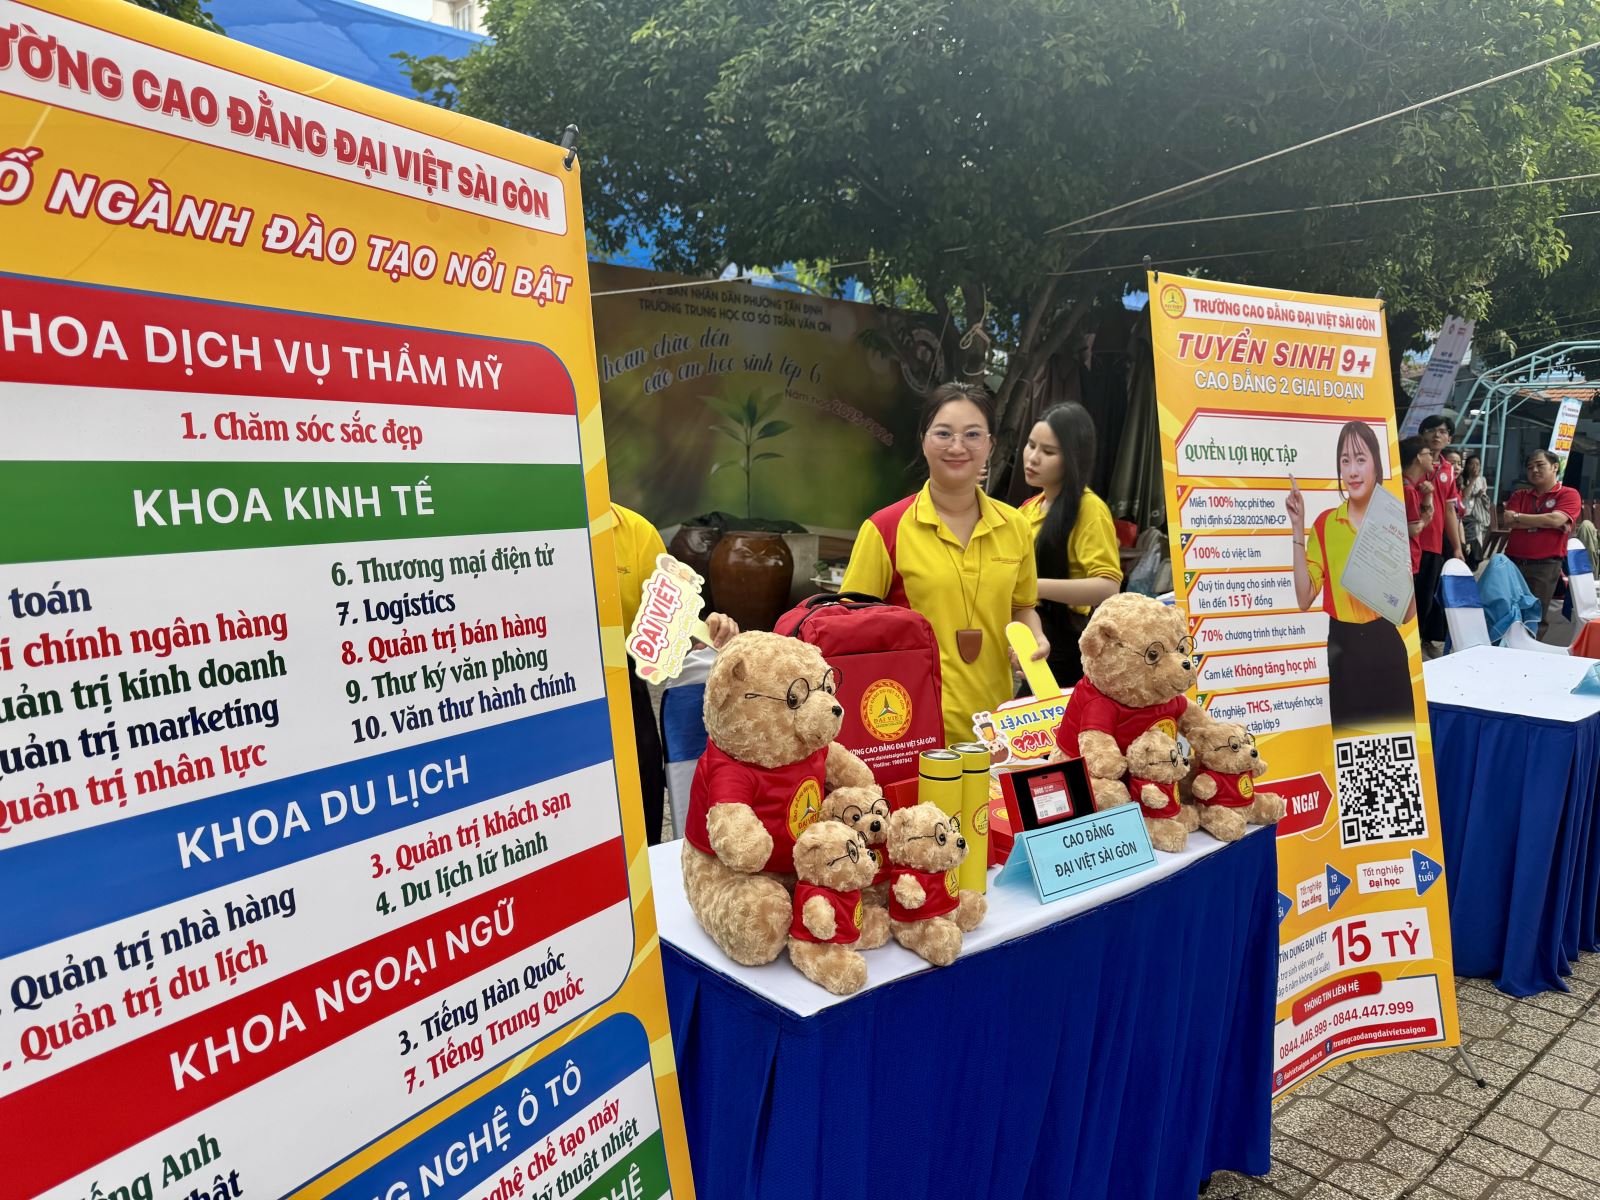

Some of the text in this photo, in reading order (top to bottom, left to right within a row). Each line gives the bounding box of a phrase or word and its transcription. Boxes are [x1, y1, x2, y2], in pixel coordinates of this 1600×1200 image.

[132, 69, 550, 220] CAO ĐẲNG ĐẠI VIỆT SÀI GÒN
[45, 168, 573, 307] NGÀNH ĐÀO TẠO NỔI BẬT
[1193, 297, 1240, 316] TRƯỜNG
[1242, 304, 1264, 319] CAO
[1267, 303, 1295, 322] ĐẲNG
[1297, 311, 1315, 327] ĐẠI
[1316, 312, 1337, 330] VIỆT
[1339, 314, 1355, 329] SÀI
[1355, 317, 1376, 332] GÒN
[1, 309, 502, 390] HOA DỊCH VỤ THẨM MỸ
[1177, 328, 1371, 373] TUYỂN SINH 9+
[1194, 368, 1364, 403] CAO ĐẲNG 2 GIAI ĐOẠN
[213, 410, 423, 450] Chăm sóc sắc đẹp
[1185, 437, 1298, 466] QUYỀN LỢI HỌC TẬP
[133, 474, 435, 527] KHOA KINH TẾ
[1193, 547, 1261, 560] 100% có việc làm
[9, 580, 92, 619] toán
[363, 590, 456, 625] Logistics
[636, 578, 678, 658] ĐẠI VIỆT
[1199, 593, 1273, 609] lên đến 15 Tỷ đồng
[23, 626, 123, 669] chính
[129, 616, 211, 658] ngân
[215, 609, 288, 641] hàng
[368, 613, 548, 663] Quản trị bán hàng
[1202, 625, 1305, 643] 70% chương trình thực hành
[118, 649, 287, 703] kinh doanh
[1204, 657, 1317, 680] Cam kết Không tăng học phí
[127, 698, 280, 749] marketing
[177, 754, 470, 870] KHOA DU LỊCH
[1292, 791, 1319, 815] NGAY
[396, 792, 572, 871] Quản trị khách sạn
[1062, 822, 1115, 849] CAO ĐẲNG
[1055, 841, 1137, 878] ĐẠI VIỆT SÀI GÒN
[1418, 872, 1434, 882] tuổi
[1420, 861, 1429, 870] 21
[1332, 920, 1420, 966] 15 TỶ
[169, 897, 516, 1091] KHOA NGOẠI NGỮ
[421, 946, 566, 1043] Tiếng Hàn Quốc
[1304, 980, 1360, 1013] THÔNG TIN LIÊN HỆ
[1280, 1001, 1414, 1060] 0844.446.999 0844.447.999
[418, 1059, 582, 1198] NGHỆ Ô TÔ
[162, 1133, 222, 1189] Anh
